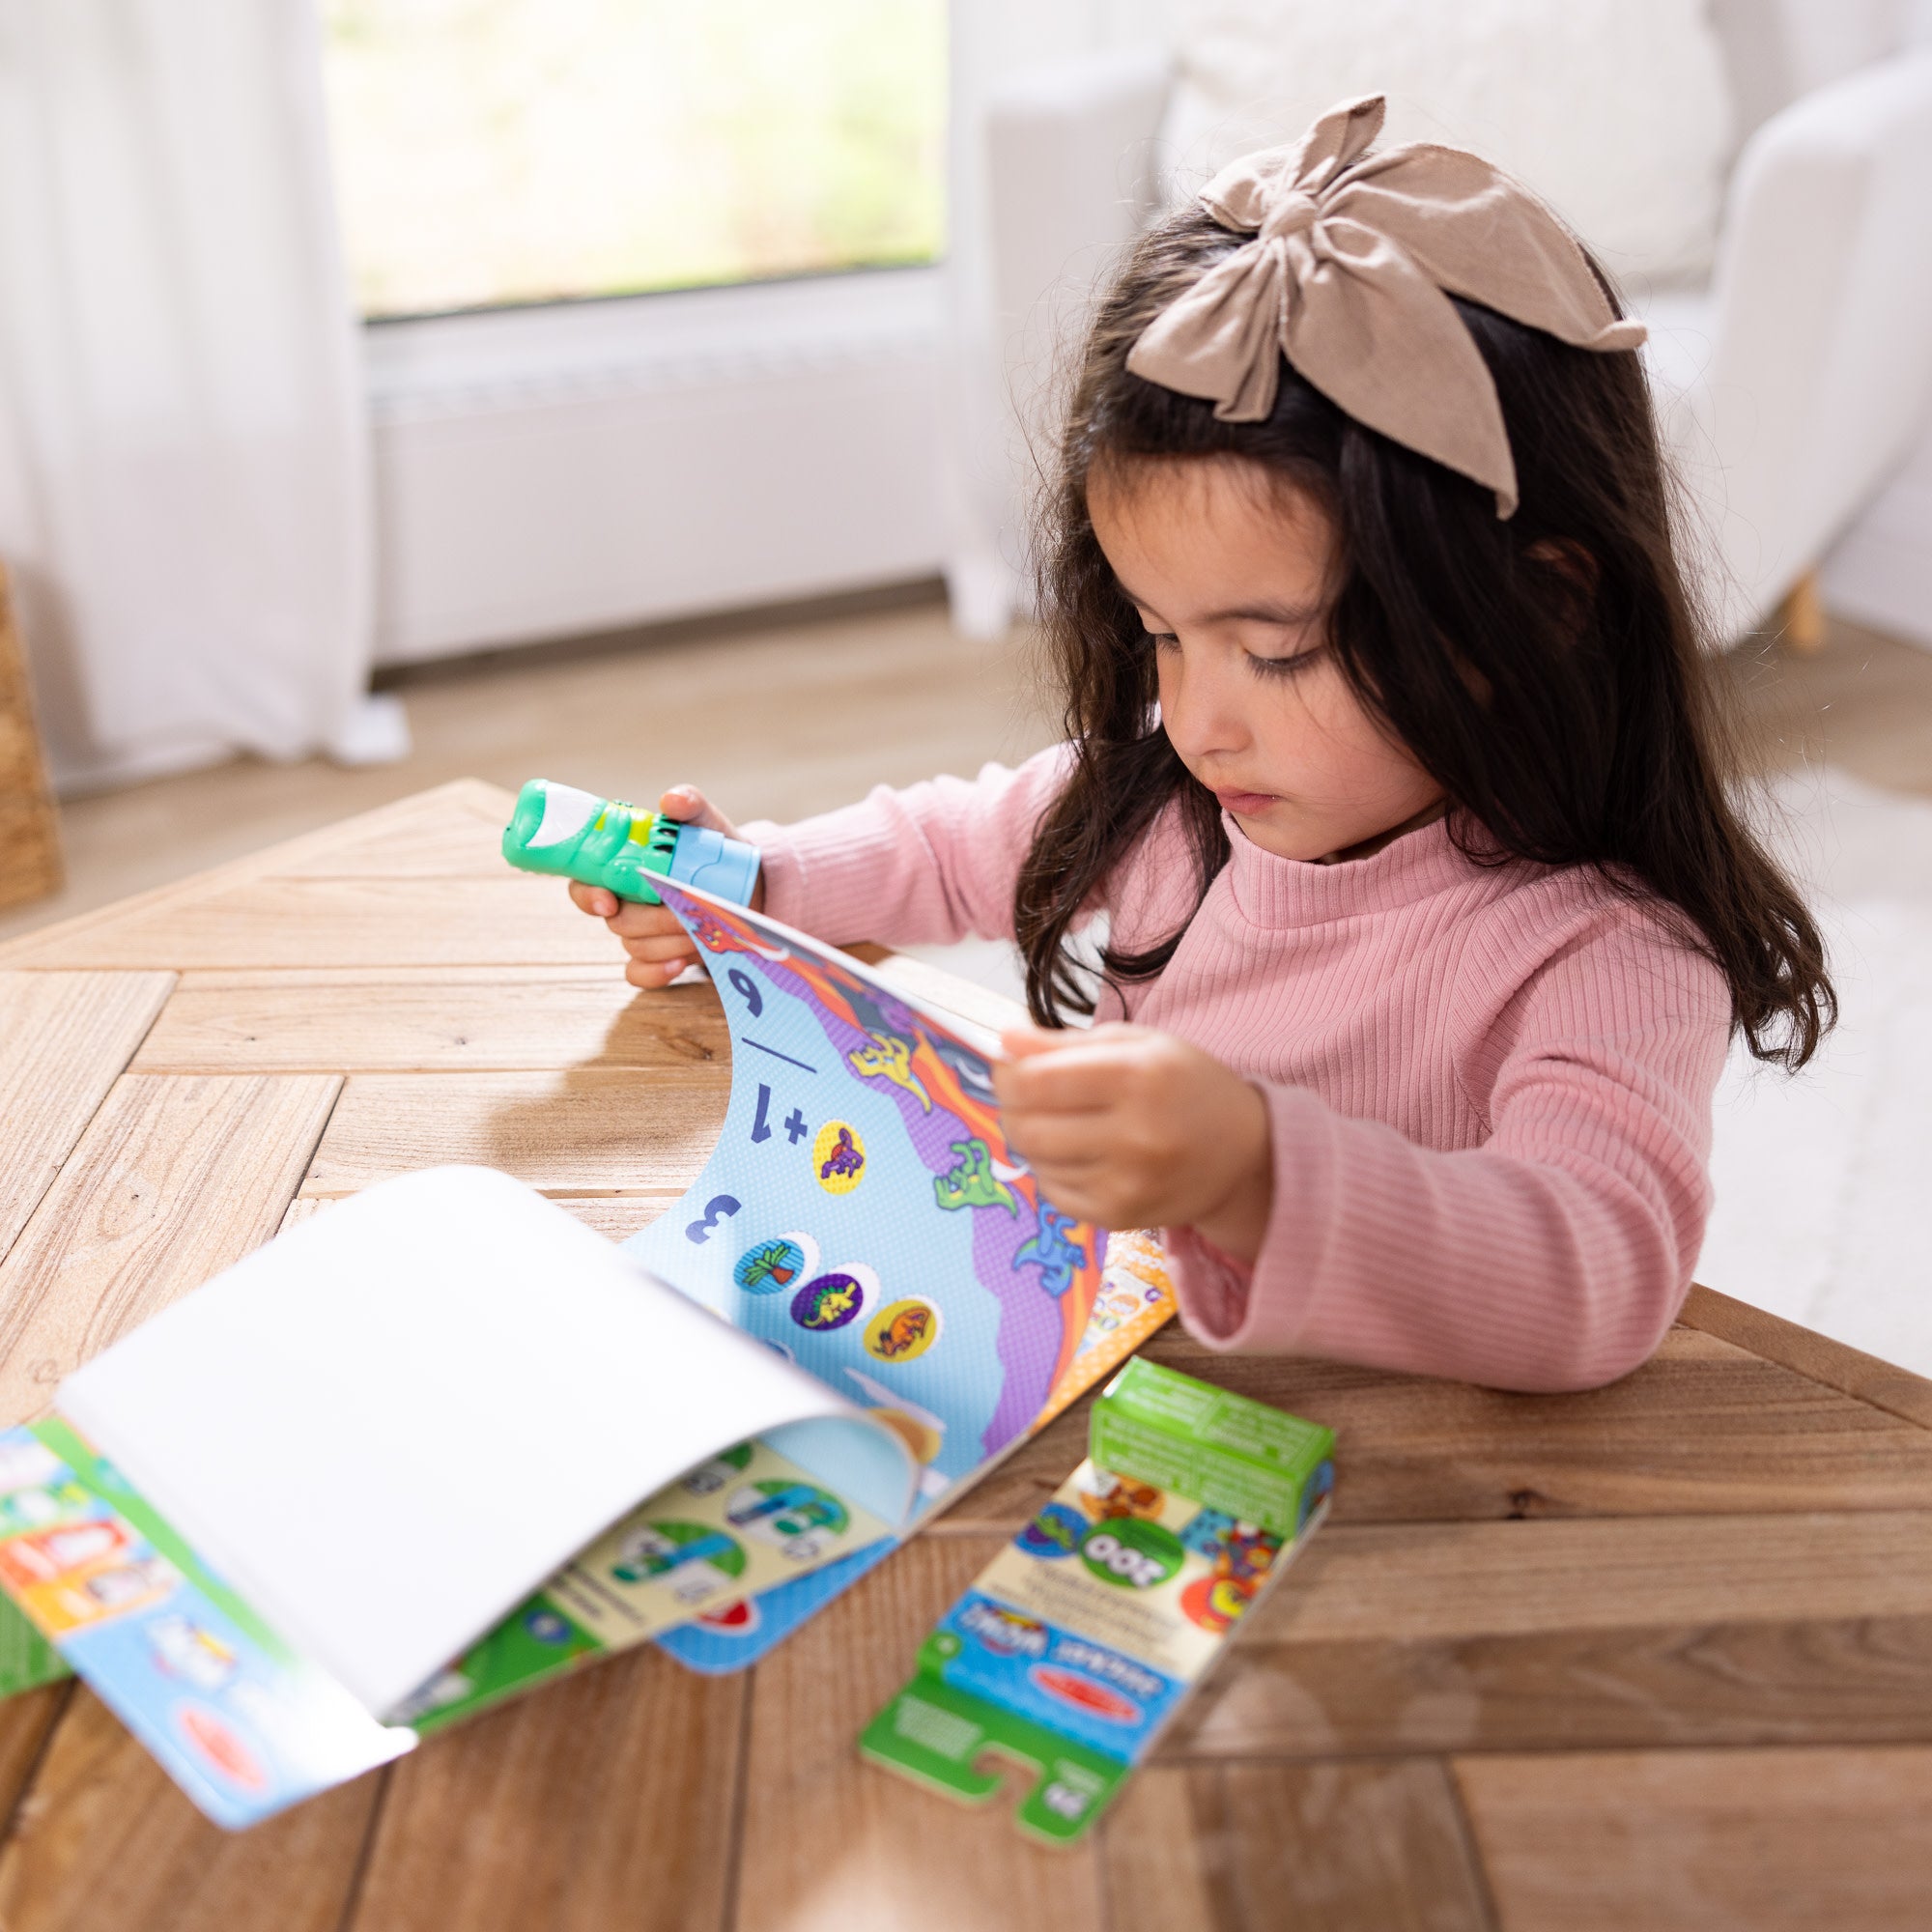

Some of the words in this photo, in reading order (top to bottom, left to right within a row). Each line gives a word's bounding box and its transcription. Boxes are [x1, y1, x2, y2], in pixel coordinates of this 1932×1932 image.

[728, 968, 763, 1018] 6
[685, 1194, 743, 1244] 3
[1084, 1534, 1165, 1589] 200
